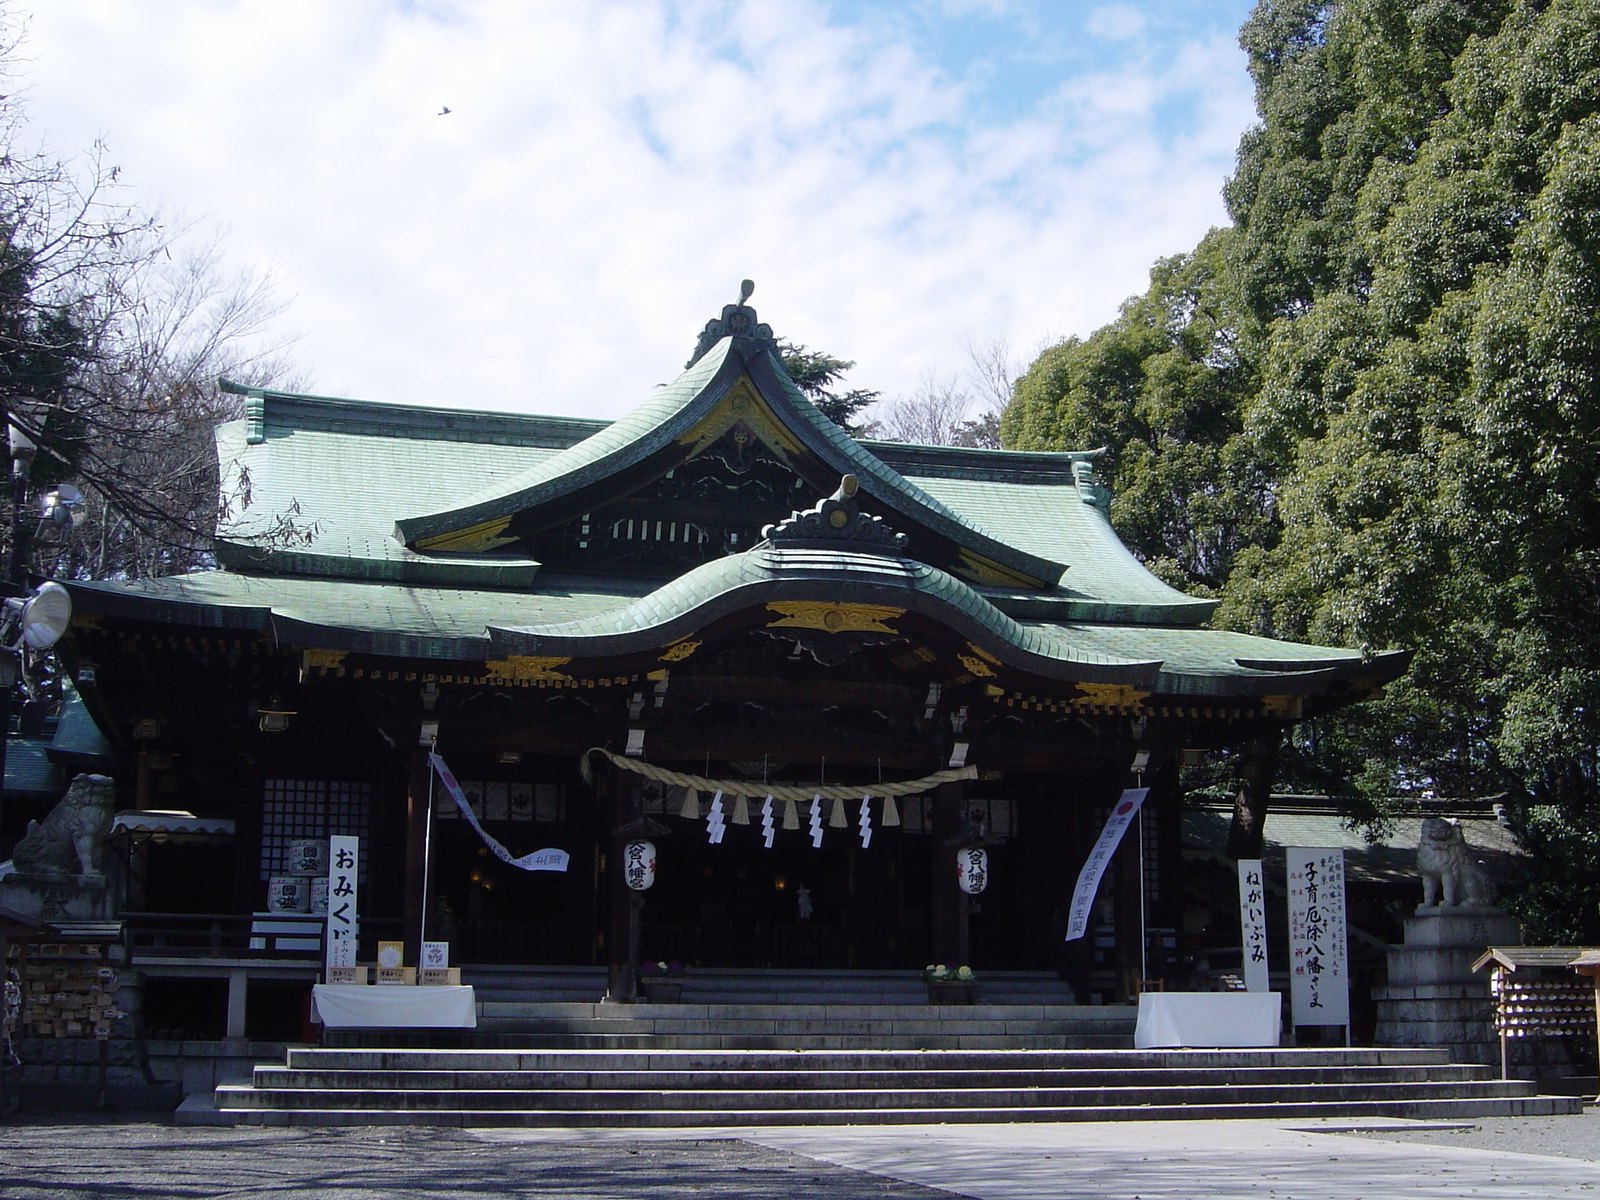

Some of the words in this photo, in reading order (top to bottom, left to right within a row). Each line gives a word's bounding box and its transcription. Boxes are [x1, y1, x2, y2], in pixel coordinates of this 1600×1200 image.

[628, 841, 646, 888] 大宮八幡宮
[967, 847, 985, 892] 大宮八幡宮
[1246, 871, 1265, 963] ねがいぶみ
[1304, 861, 1325, 1008] 子育厄除八幡さま
